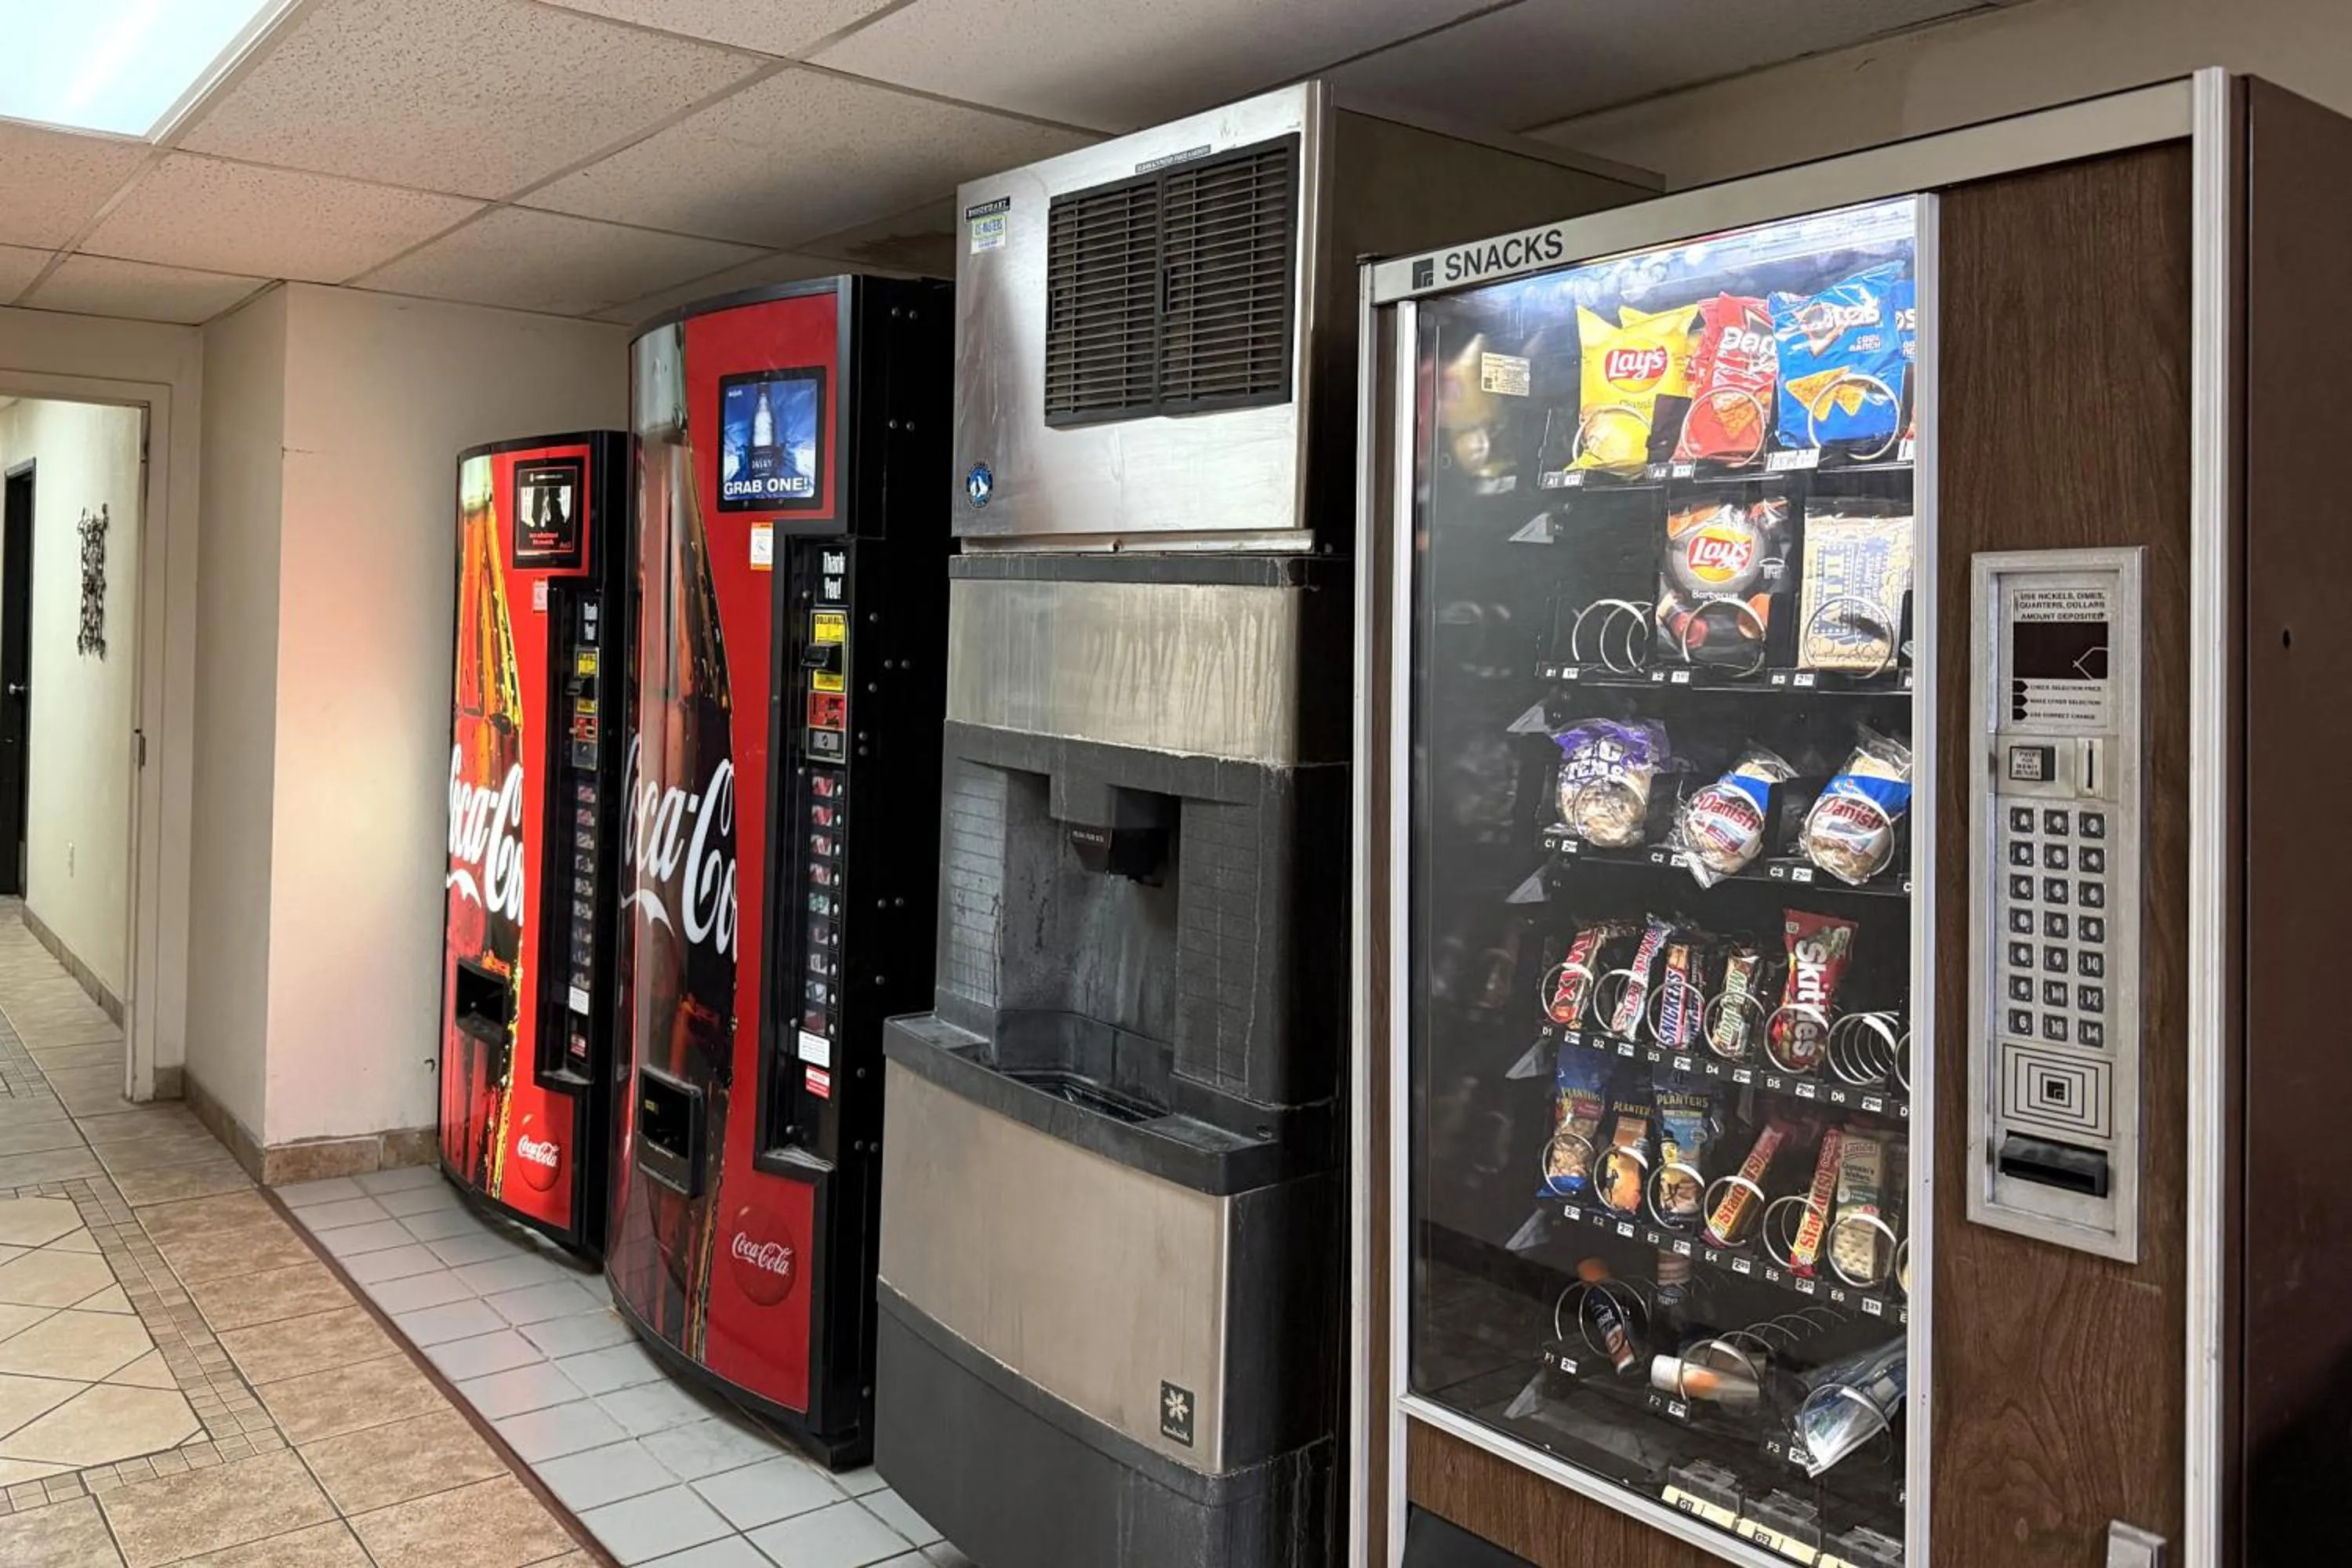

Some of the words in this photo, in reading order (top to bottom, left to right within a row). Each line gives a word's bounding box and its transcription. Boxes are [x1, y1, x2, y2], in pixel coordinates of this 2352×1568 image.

[1445, 229, 1563, 281] SNACKS
[1609, 349, 1665, 380] Lay's
[724, 478, 762, 495] GRAB
[768, 477, 808, 493] ONE!
[1691, 537, 1751, 570] Lay's
[822, 551, 845, 575] Thank
[2056, 612, 2104, 620] DEPOSITED
[1699, 793, 1757, 832] Danish
[1819, 797, 1883, 831] Danish
[1544, 838, 1555, 848] C1
[1650, 852, 1664, 863] C2
[1769, 866, 1784, 877] C3
[2086, 956, 2099, 971] 10
[2086, 990, 2099, 1005] 12
[1660, 970, 1683, 1044] SNICKERS
[1542, 1026, 1552, 1037] D1
[1592, 1038, 1605, 1050] D2
[1647, 1051, 1660, 1062] D3
[1705, 1064, 1719, 1075] D4
[1766, 1077, 1780, 1090] D5
[1657, 1093, 1708, 1109] PLANTERS
[1831, 1091, 1845, 1103] D6
[1613, 1101, 1655, 1116] PLANTER
[517, 1134, 559, 1167] Coca-Cola
[1718, 1156, 1762, 1225] Starbrst
[731, 1231, 793, 1276] Coca-Cola
[1705, 1250, 1718, 1263] E4
[1766, 1268, 1779, 1282] E5
[1831, 1289, 1845, 1302] E6
[1544, 1352, 1555, 1364] F1
[1650, 1395, 1661, 1406] F2
[1767, 1441, 1780, 1454] F3
[1679, 1500, 1692, 1511] G1
[1755, 1532, 1769, 1544] G2
